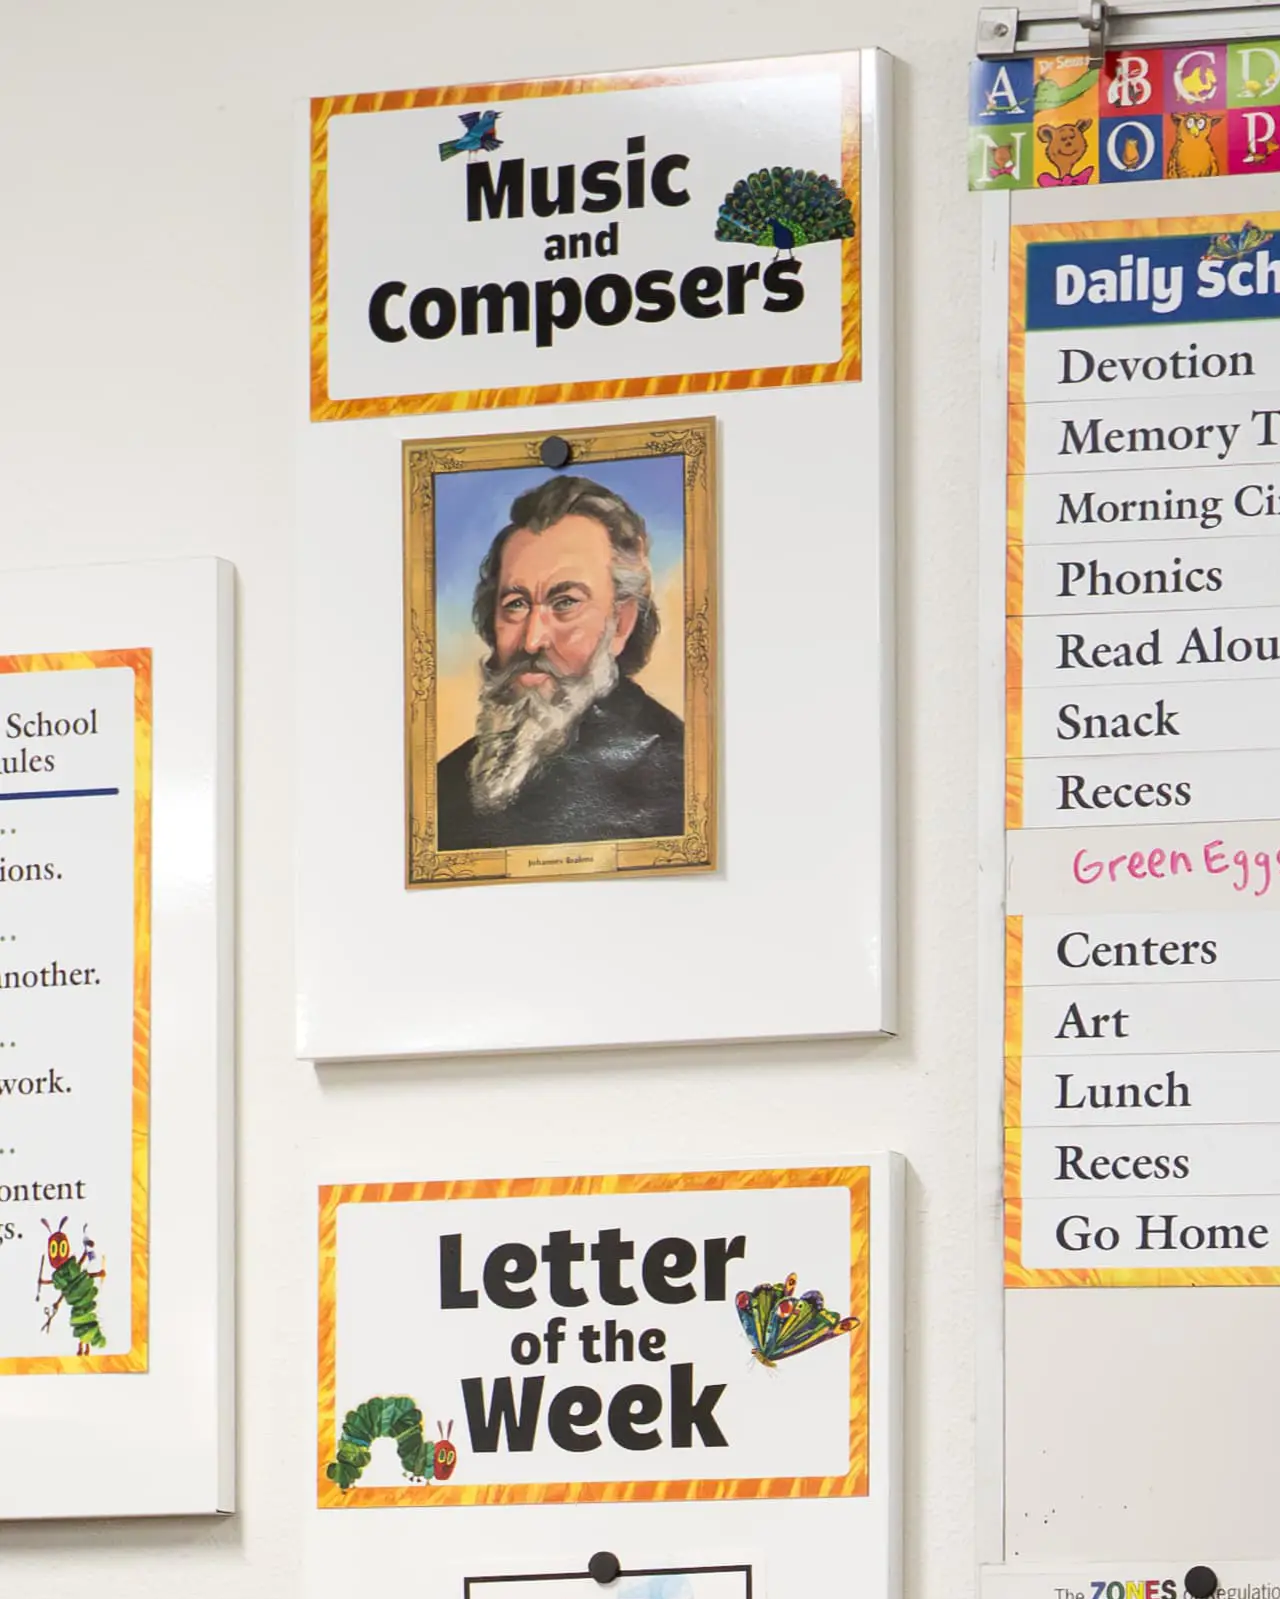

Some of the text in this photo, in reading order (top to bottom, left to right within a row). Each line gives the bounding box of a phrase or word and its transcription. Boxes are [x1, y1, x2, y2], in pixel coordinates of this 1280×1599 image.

[466, 135, 690, 222] Music
[544, 222, 619, 261] and
[368, 258, 805, 348] Composers
[1056, 254, 1183, 314] Daily
[1057, 343, 1256, 384] Devotion
[1057, 419, 1241, 460] Memory
[1056, 488, 1224, 528] Morning
[1056, 556, 1223, 598] Phonics
[1056, 628, 1162, 669] Read
[6, 709, 98, 739] School
[1056, 699, 1181, 740] Snack
[0, 748, 55, 775] ules
[1056, 774, 1192, 811] Recess
[1073, 845, 1194, 885] Green
[1056, 931, 1218, 968] Centers
[1055, 1002, 1129, 1039] Art
[1055, 1070, 1191, 1109] Lunch
[1055, 1145, 1190, 1181] Recess
[1055, 1214, 1269, 1251] Go Home
[439, 1227, 747, 1310] Letter
[511, 1316, 666, 1366] of the
[461, 1362, 730, 1454] Week
